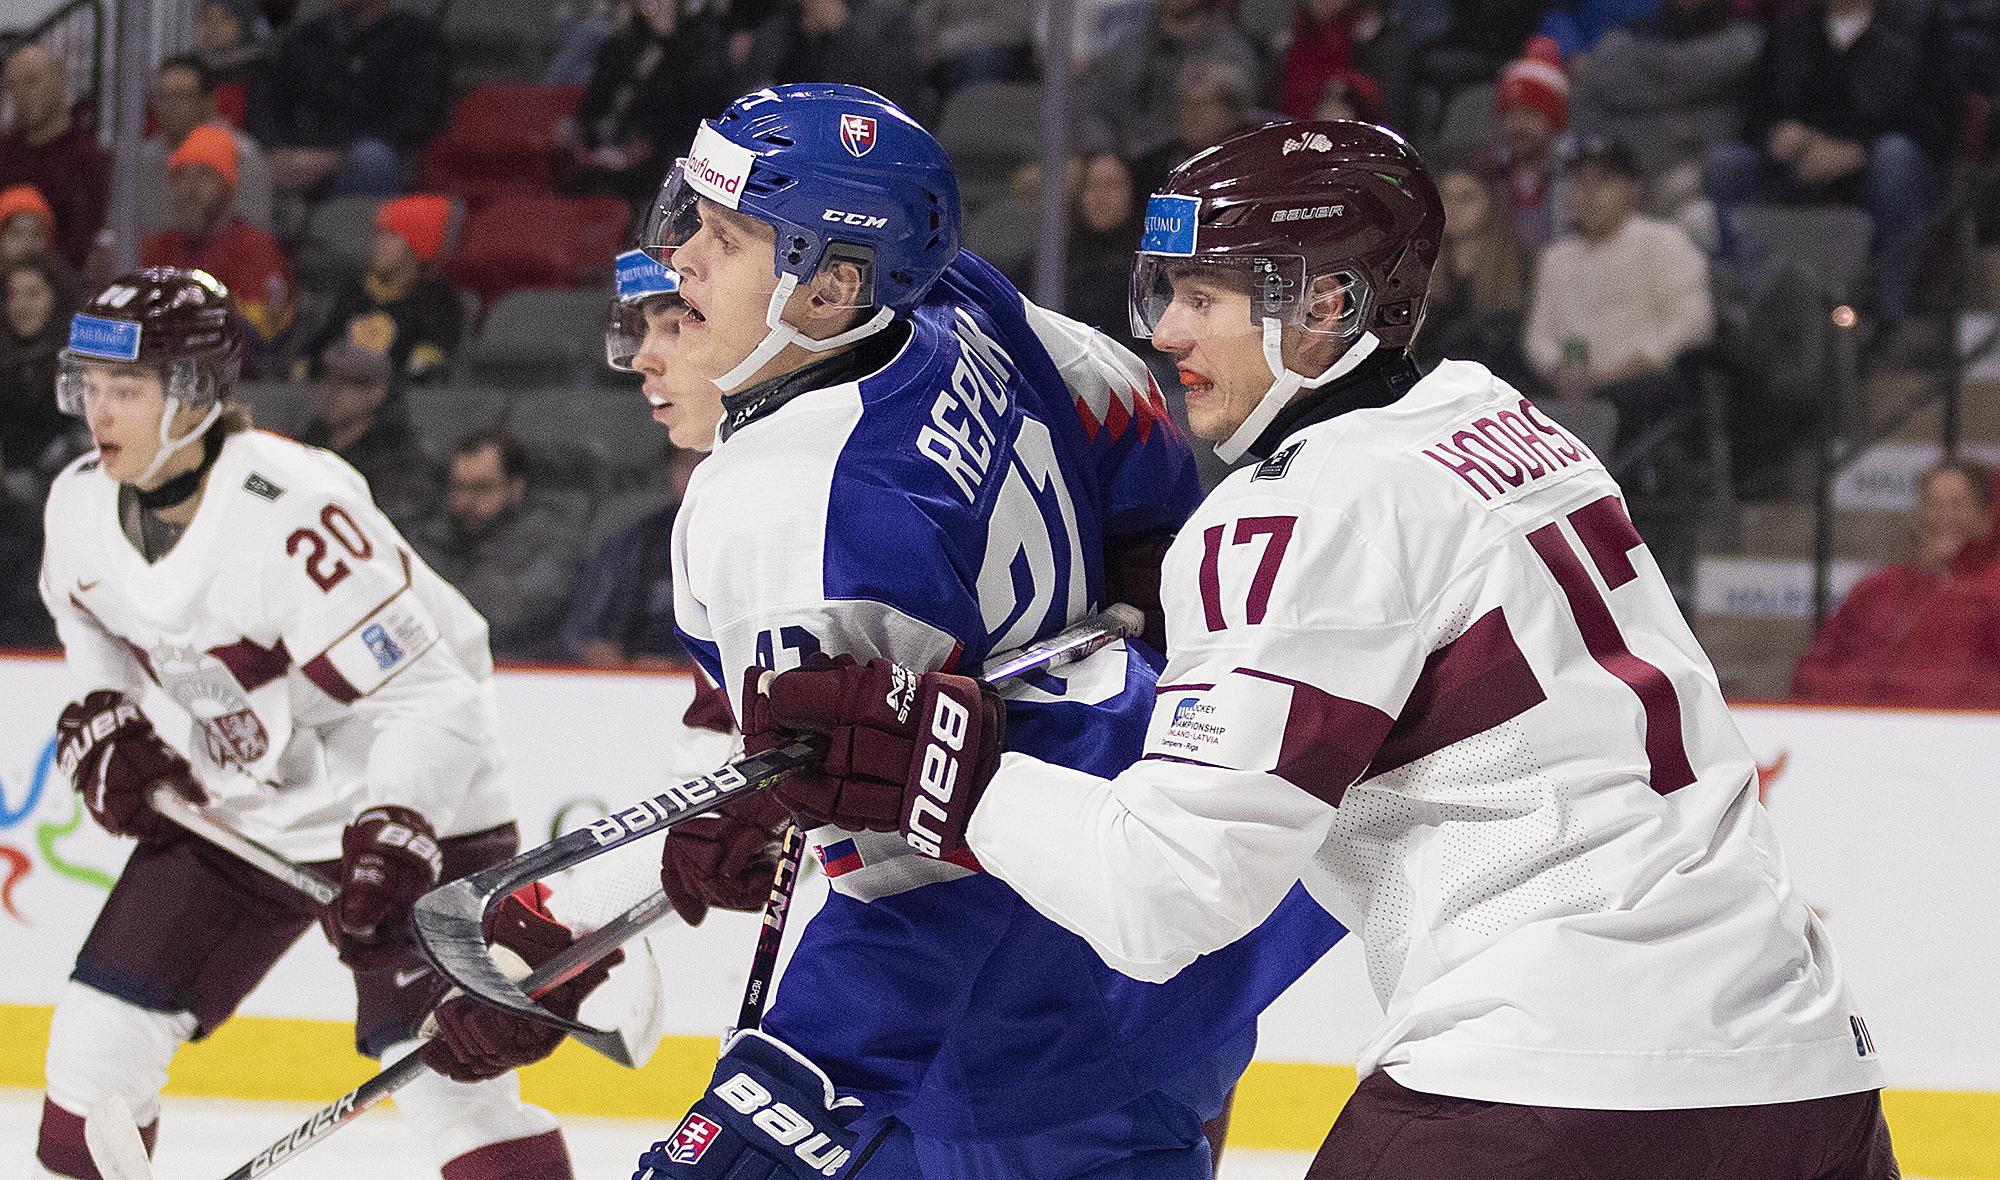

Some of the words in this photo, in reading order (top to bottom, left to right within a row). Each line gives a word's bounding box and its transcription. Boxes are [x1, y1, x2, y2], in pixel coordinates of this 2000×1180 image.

[688, 153, 742, 194] aufland
[822, 208, 888, 229] CCM
[1271, 205, 1344, 222] BAUER
[1421, 398, 1592, 501] HODAS
[286, 502, 374, 594] 20
[1198, 516, 1299, 633] 17
[249, 1087, 359, 1179] BAUER
